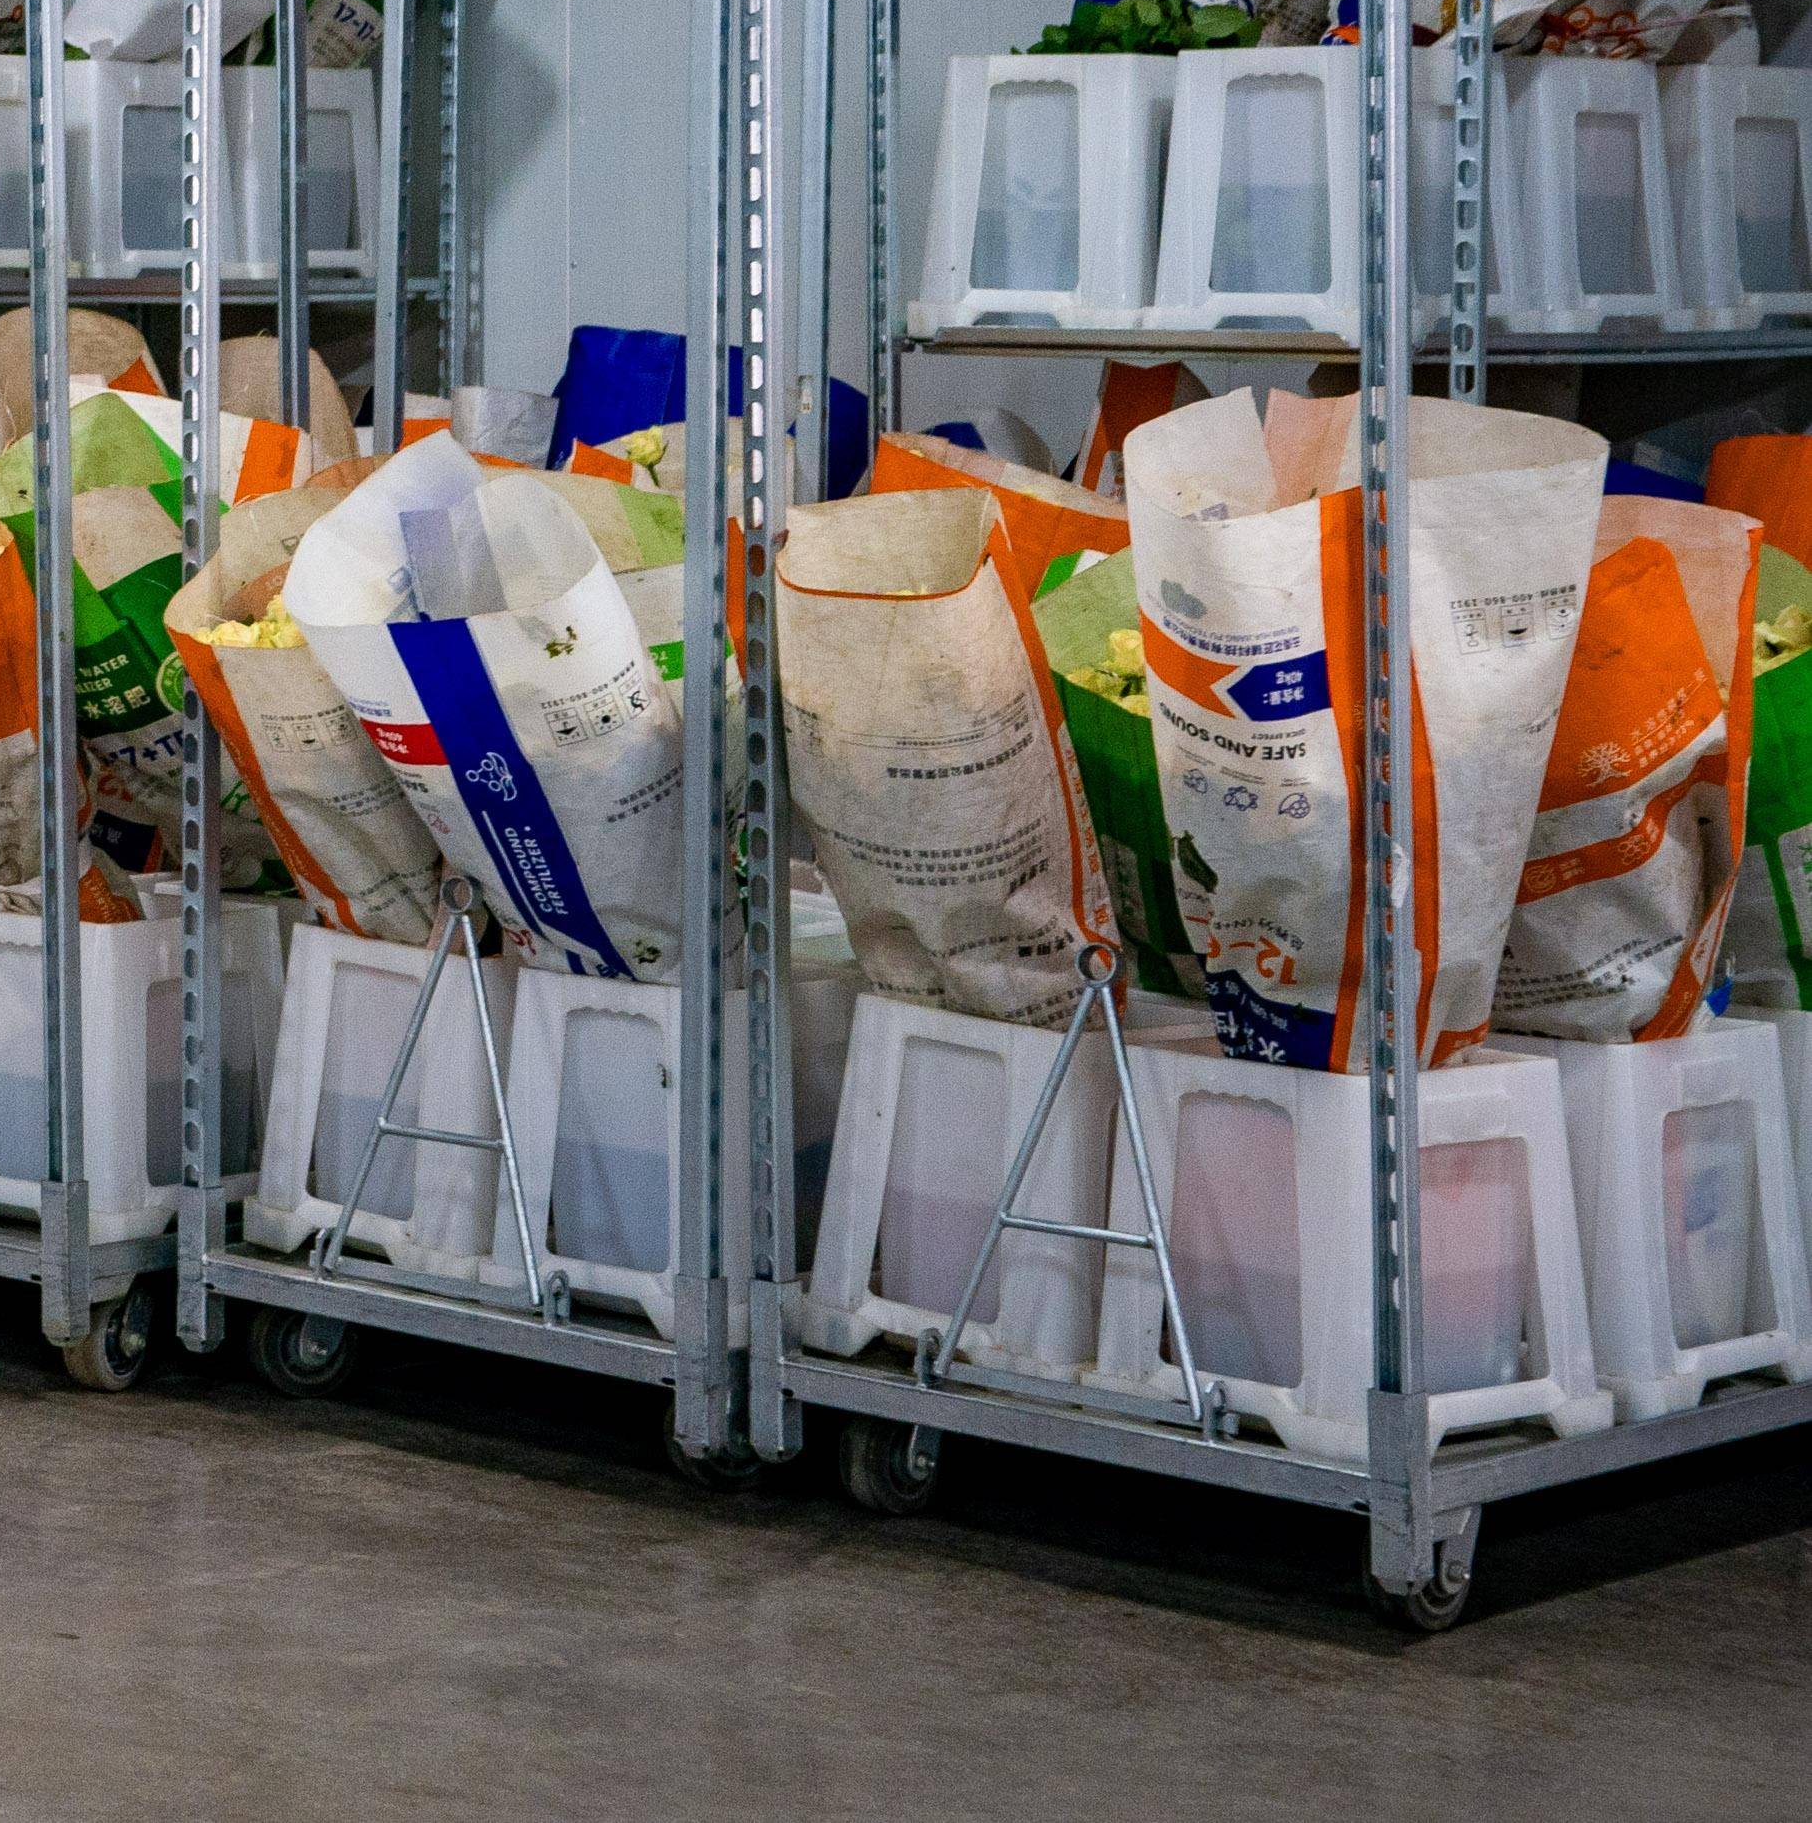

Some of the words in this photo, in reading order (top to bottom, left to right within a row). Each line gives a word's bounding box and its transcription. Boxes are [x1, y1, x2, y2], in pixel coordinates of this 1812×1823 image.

[79, 653, 130, 678] WATER
[1214, 734, 1257, 759] AND
[1261, 742, 1307, 761] SAFE
[504, 827, 554, 913] COMPOUND
[524, 837, 569, 915] FERTILIZER
